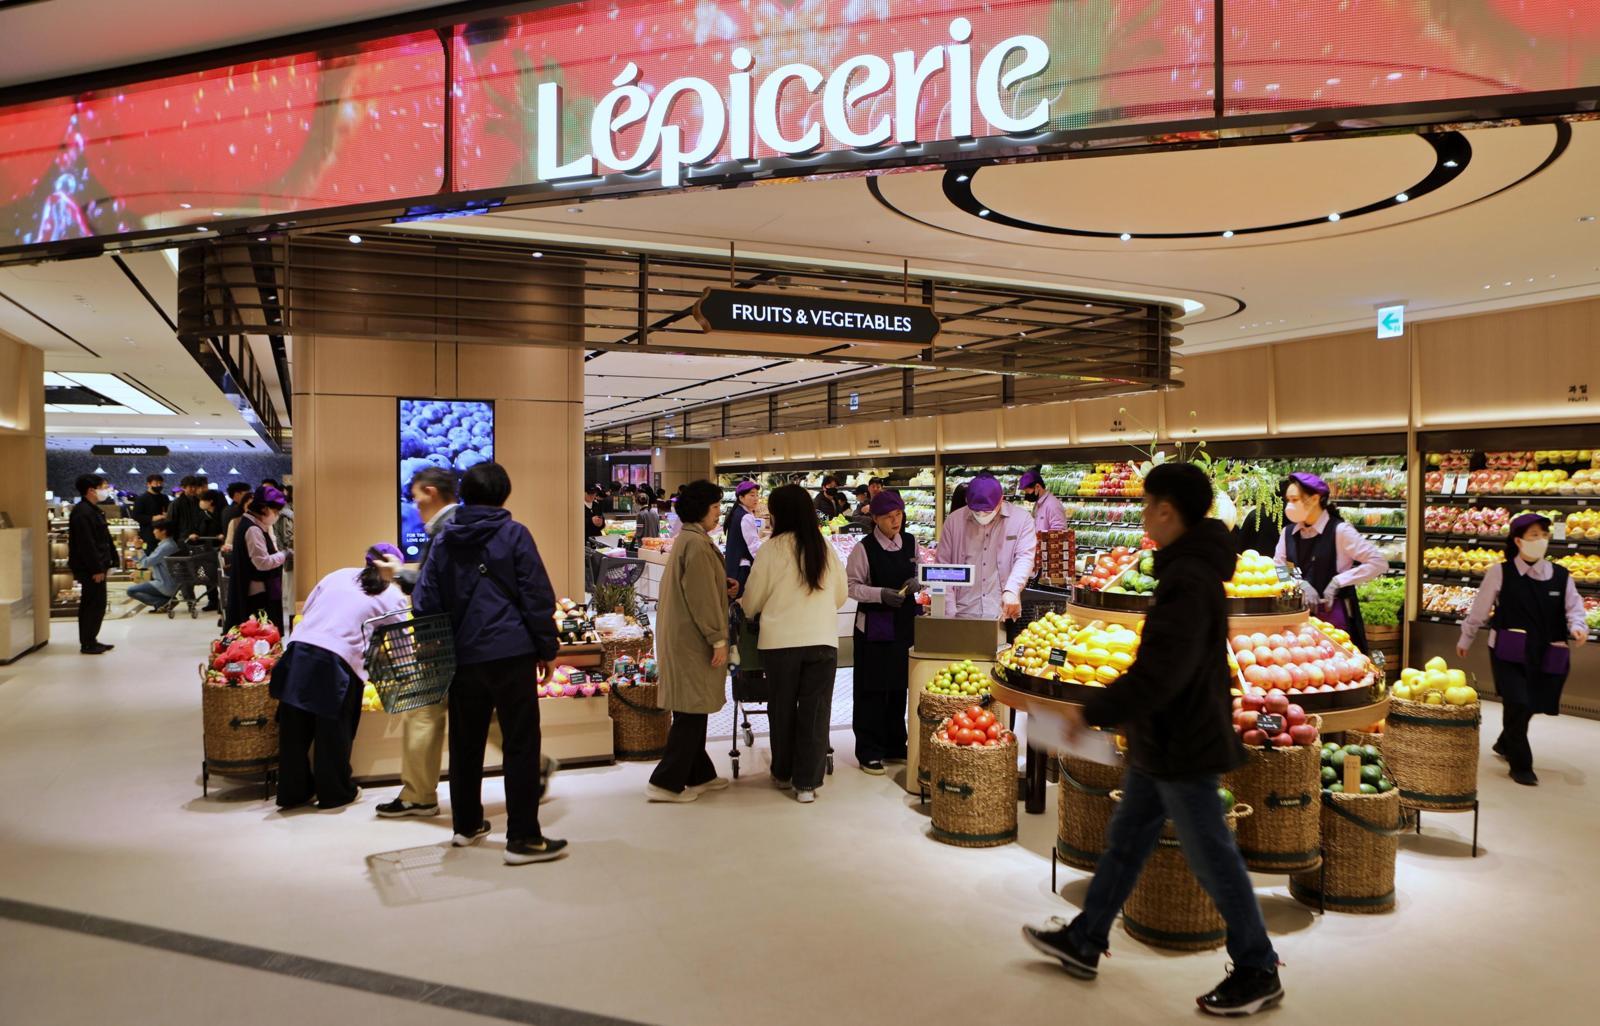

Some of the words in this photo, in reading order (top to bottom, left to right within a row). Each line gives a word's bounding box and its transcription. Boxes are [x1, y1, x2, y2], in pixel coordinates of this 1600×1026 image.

[538, 17, 1051, 186] Lépicerie
[732, 303, 792, 324] FRUITS
[796, 309, 808, 325] &
[810, 309, 912, 332] VEGETABLES
